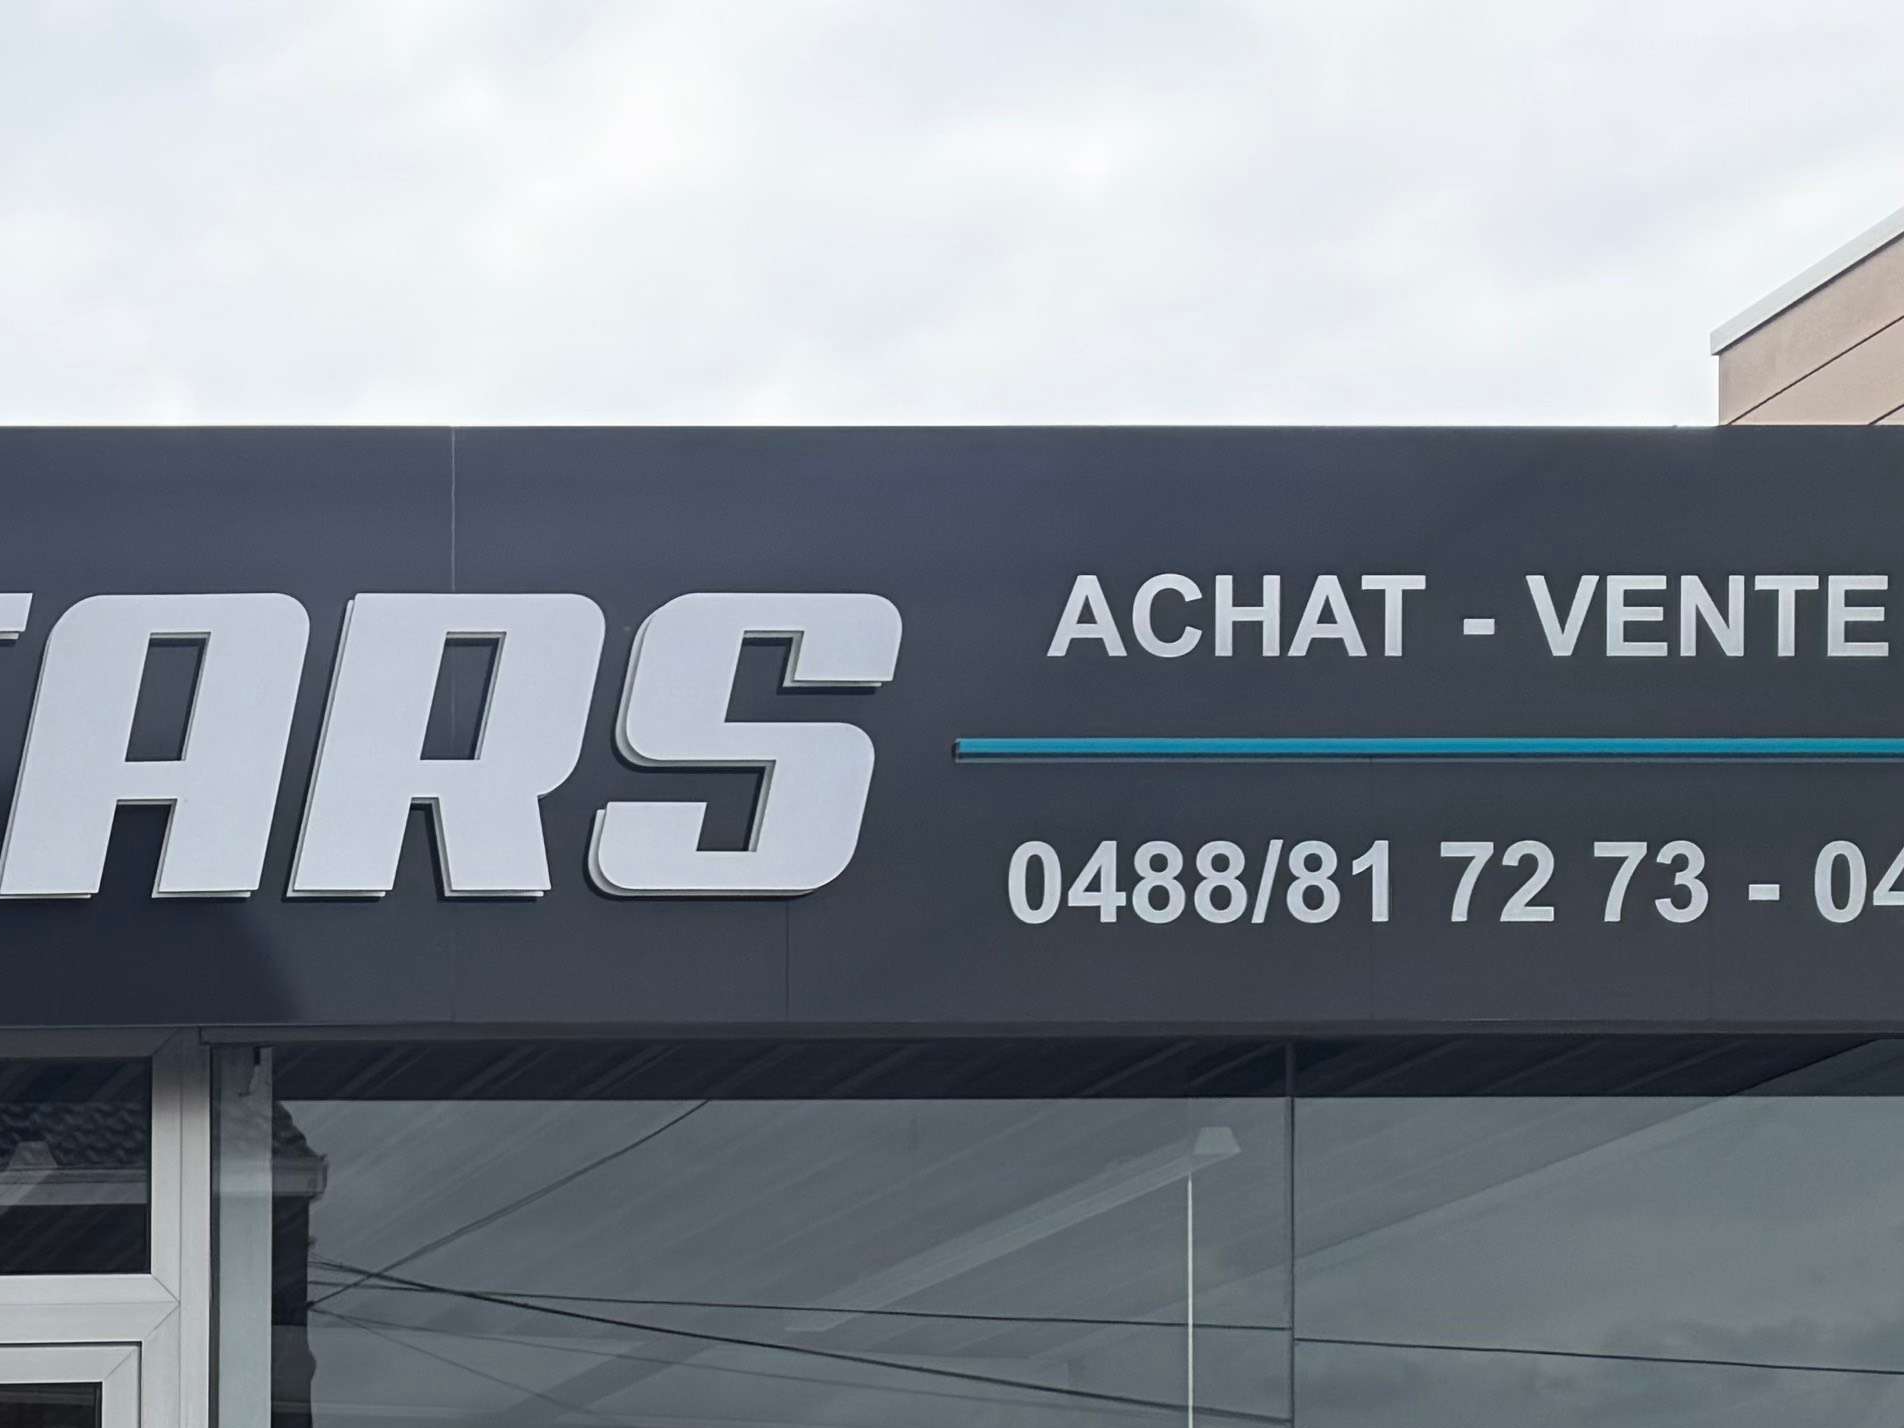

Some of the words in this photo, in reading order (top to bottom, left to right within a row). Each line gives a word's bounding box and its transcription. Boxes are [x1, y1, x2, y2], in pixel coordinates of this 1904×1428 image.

[1045, 573, 1427, 660] ACHAT
[1462, 614, 1496, 636] -
[1525, 573, 1891, 658] VENTE
[1005, 838, 1393, 926] 0488/81
[1439, 839, 1556, 924] 72
[1592, 839, 1711, 926] 73
[1747, 880, 1782, 903] -
